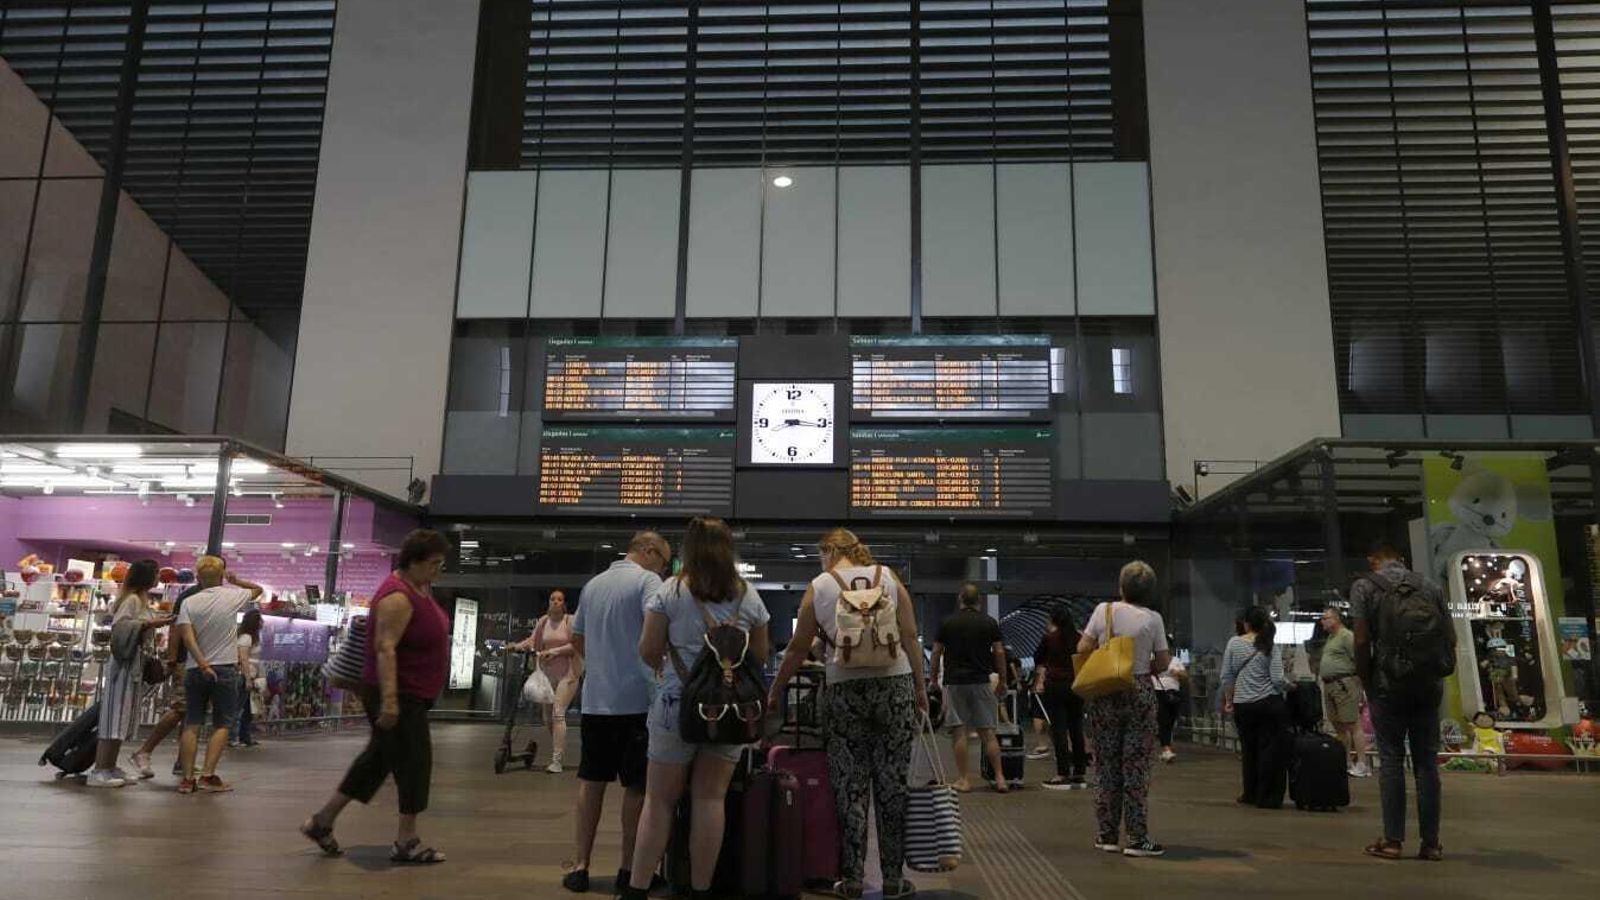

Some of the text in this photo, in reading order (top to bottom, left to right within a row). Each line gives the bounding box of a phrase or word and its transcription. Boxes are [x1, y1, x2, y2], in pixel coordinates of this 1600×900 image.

[786, 391, 801, 400] 12
[759, 418, 768, 428] 9
[817, 418, 827, 428] 3
[788, 446, 797, 456] 6
